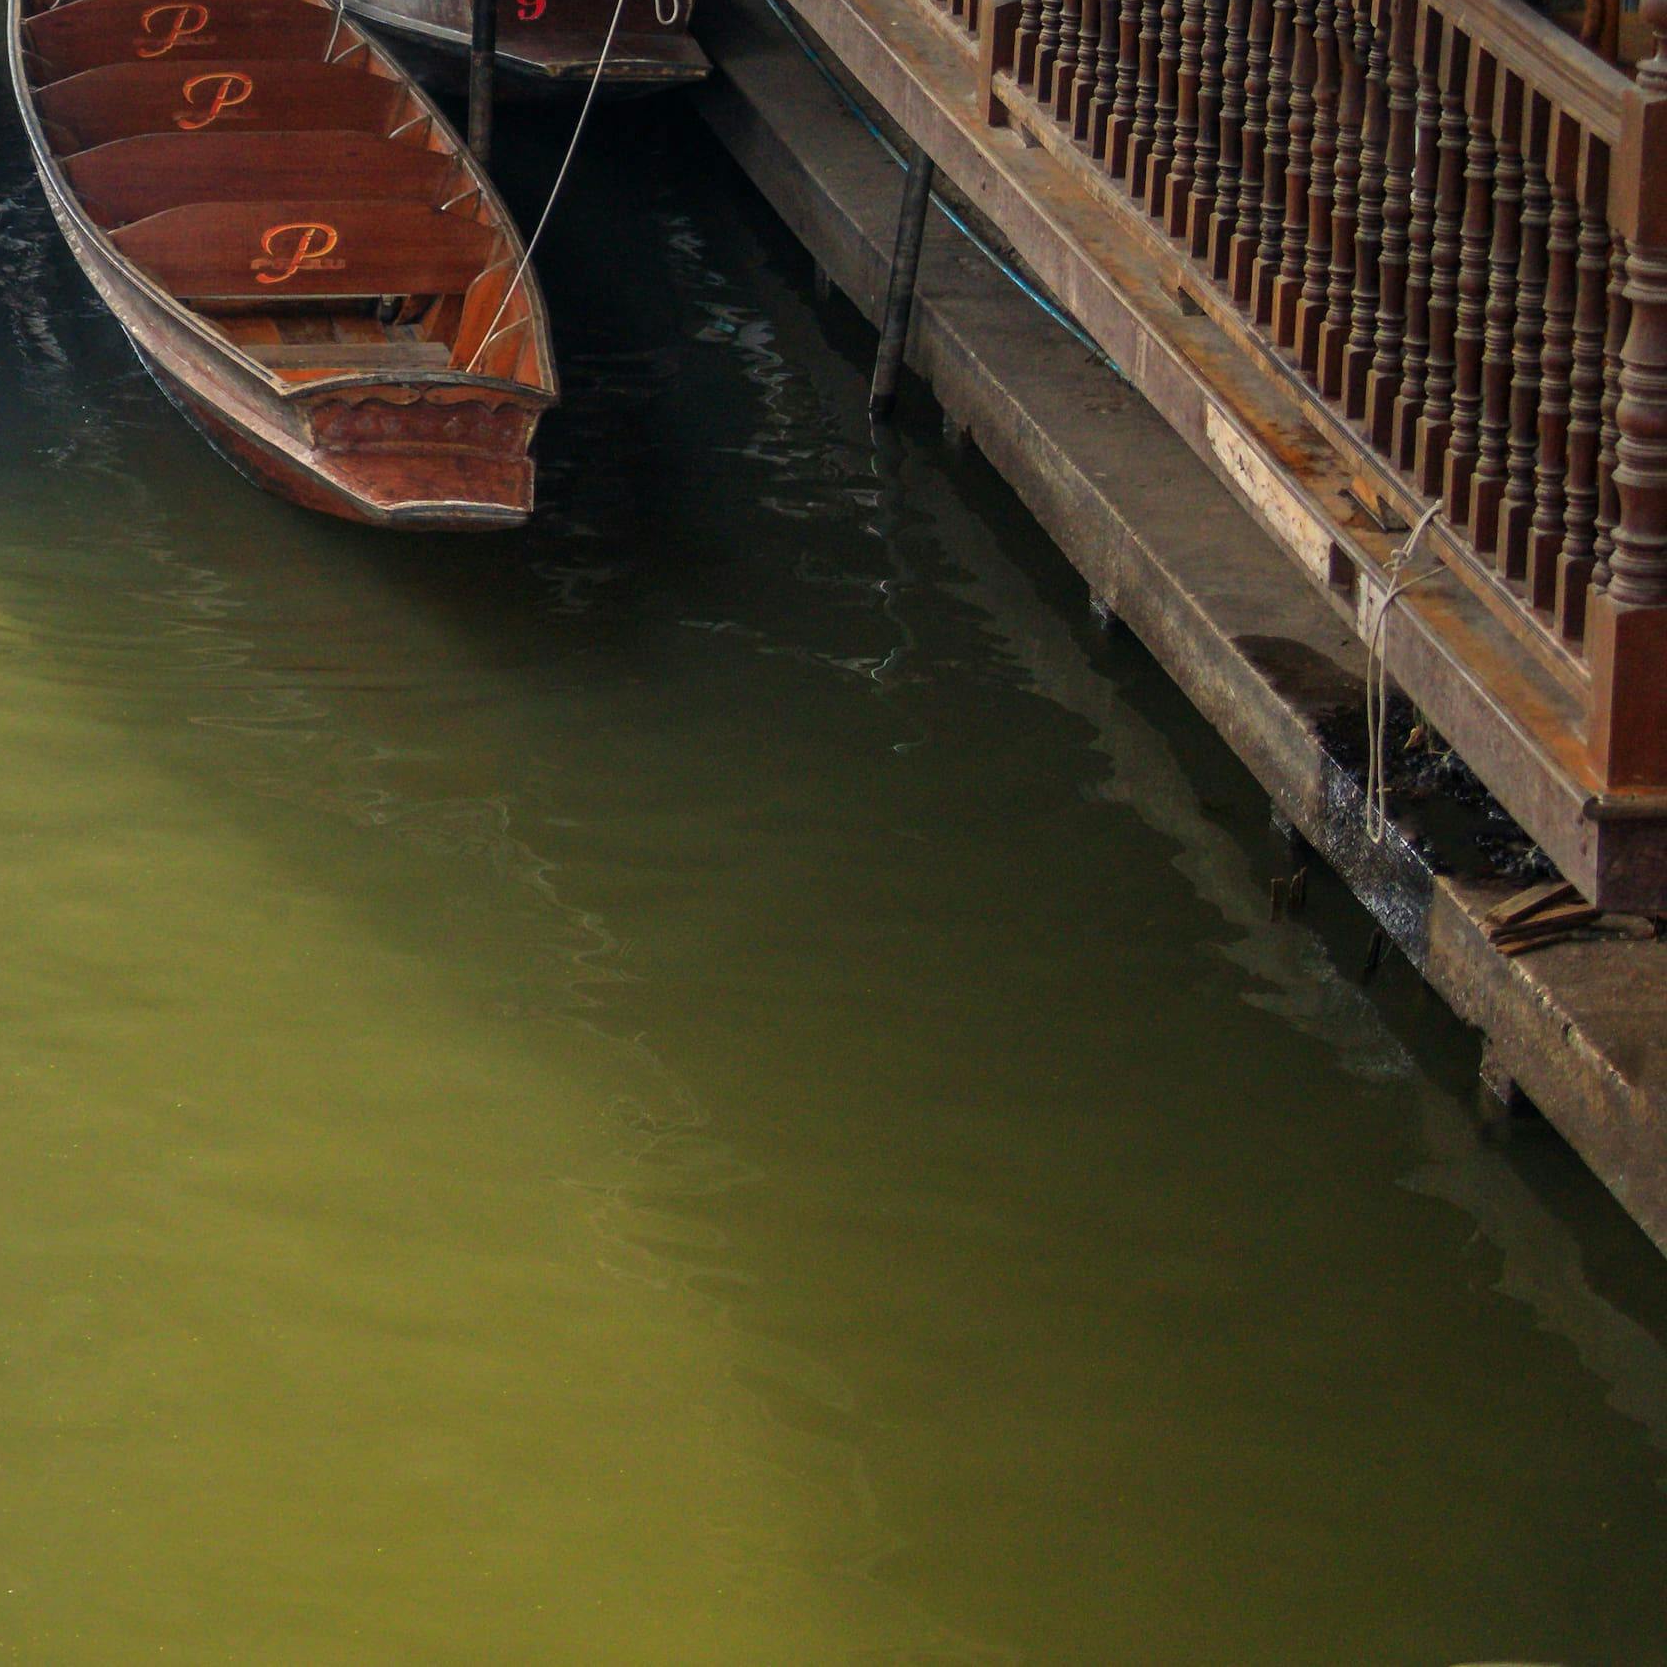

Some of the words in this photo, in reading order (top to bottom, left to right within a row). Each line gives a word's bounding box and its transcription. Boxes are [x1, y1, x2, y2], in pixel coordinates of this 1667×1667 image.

[136, 3, 210, 59] P
[174, 71, 253, 130] P
[255, 222, 338, 284] P
